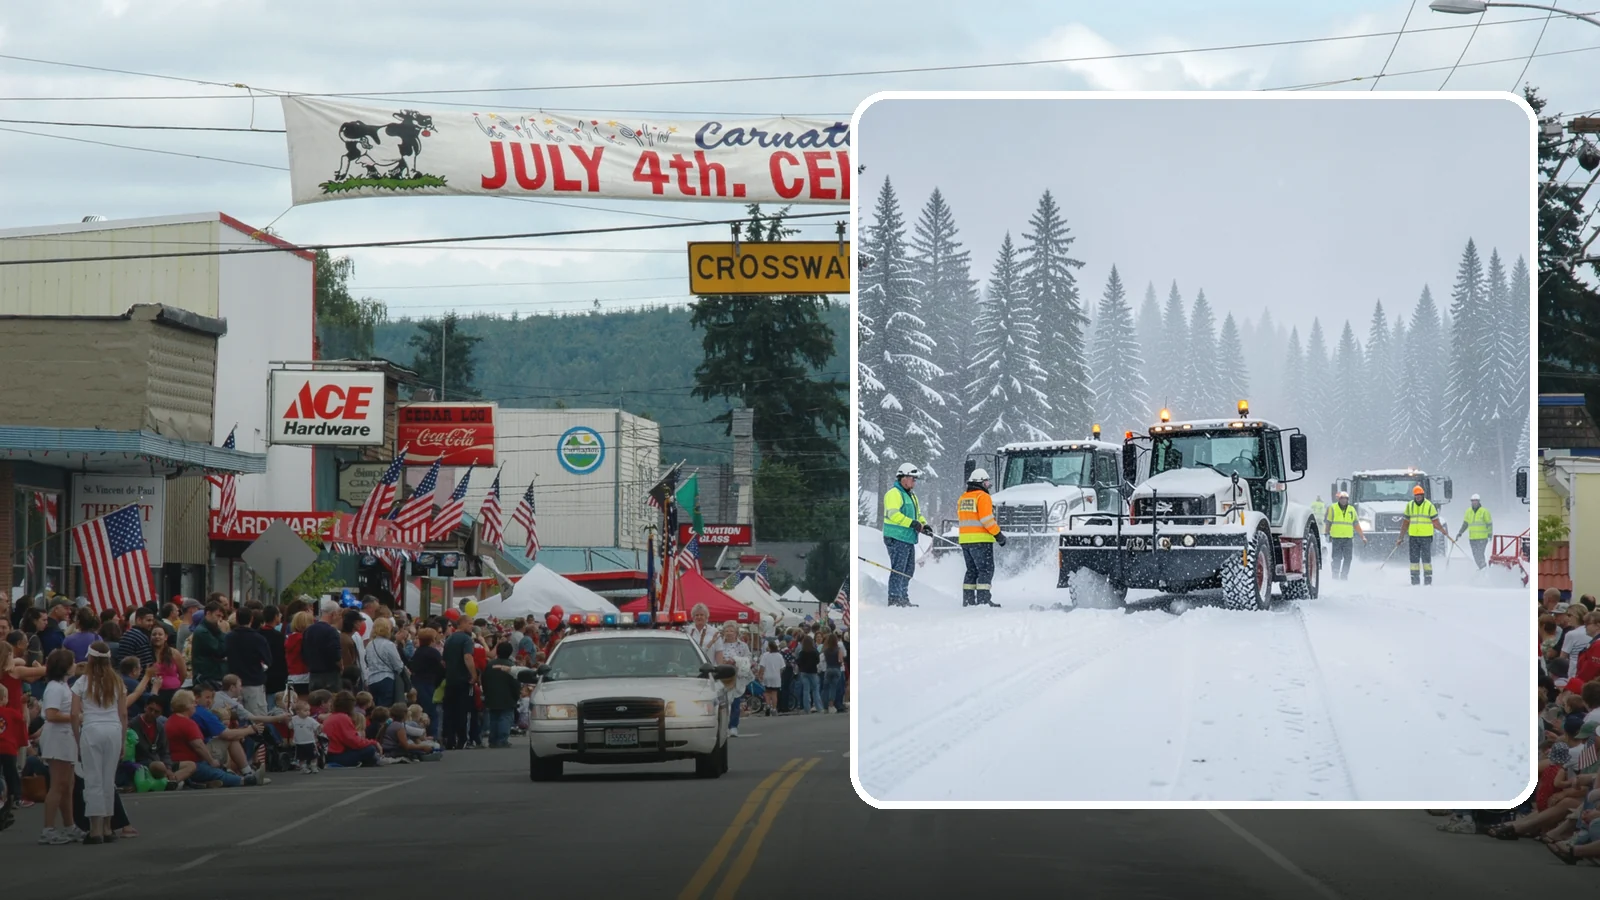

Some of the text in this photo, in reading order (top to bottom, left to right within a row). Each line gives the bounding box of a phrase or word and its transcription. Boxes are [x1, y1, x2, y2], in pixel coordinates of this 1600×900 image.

[480, 141, 605, 193] JULY
[632, 149, 747, 198] 4th.
[696, 254, 850, 280] CROSSWA
[282, 379, 374, 420] ACE
[405, 408, 453, 422] CEDAR
[283, 421, 371, 436] Hardware
[416, 428, 477, 447] Coca-Cola
[95, 485, 124, 495] Vincent
[126, 485, 136, 495] de
[137, 486, 155, 495] Paul
[687, 526, 741, 535] CRNATION
[698, 535, 730, 543] GLASS
